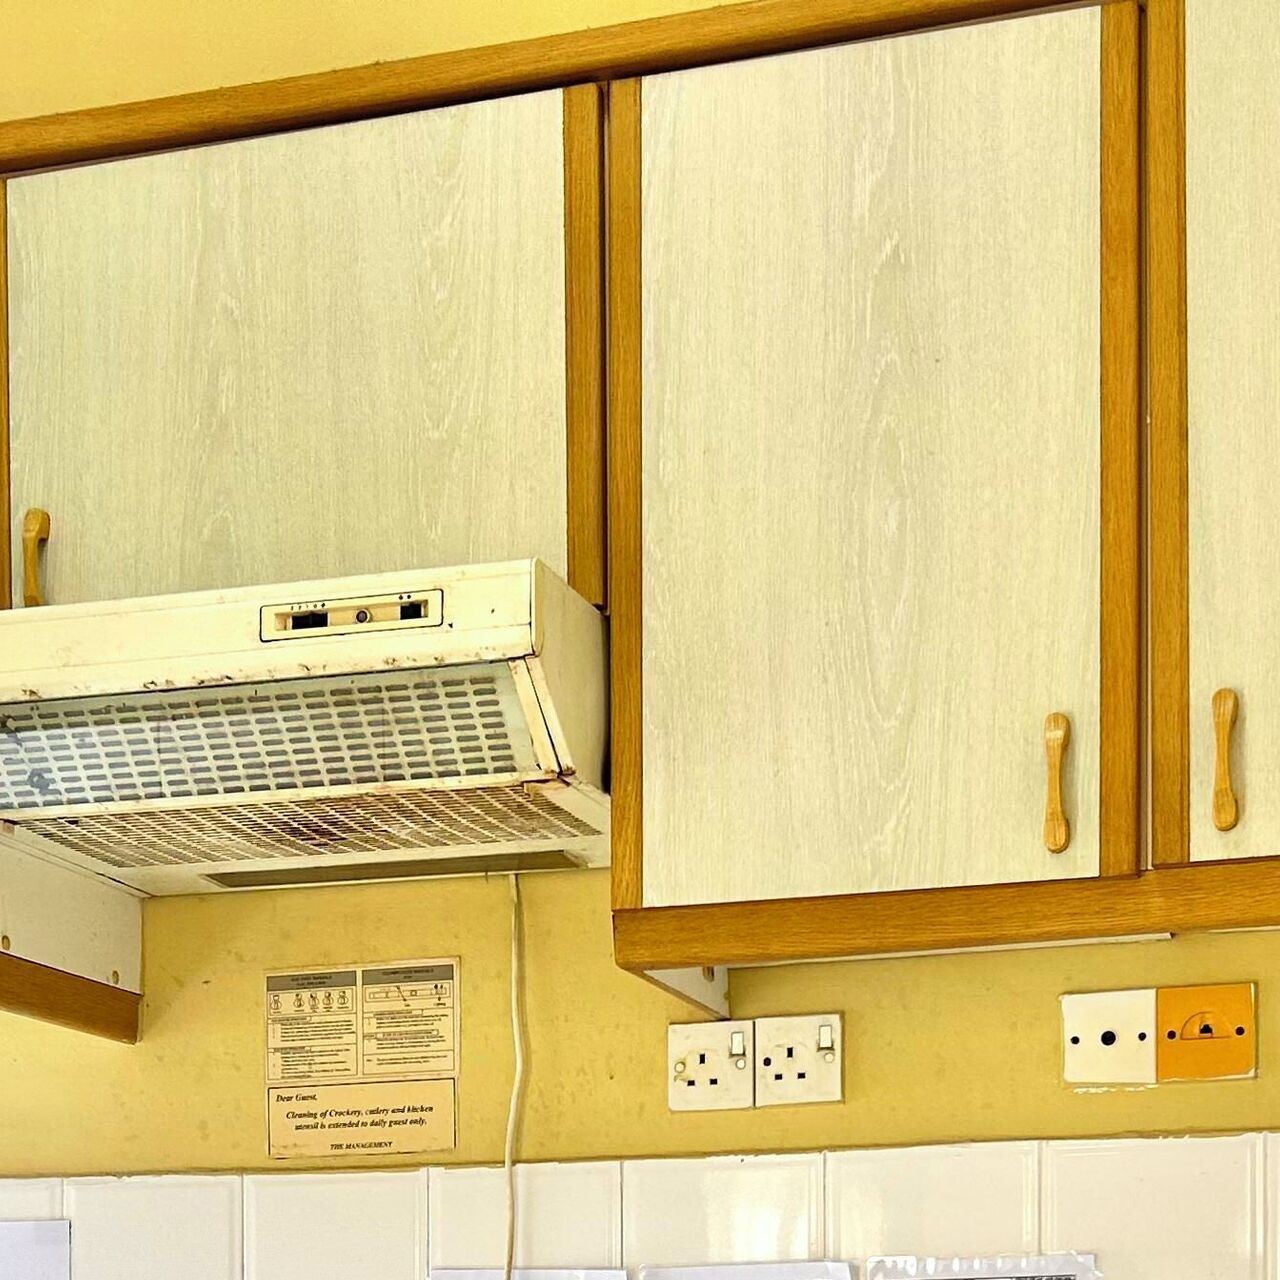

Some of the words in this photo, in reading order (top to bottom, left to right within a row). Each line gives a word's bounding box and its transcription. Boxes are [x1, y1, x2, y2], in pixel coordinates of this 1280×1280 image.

[275, 1094, 293, 1102] Dear
[286, 1110, 318, 1119] Cleaning
[320, 1109, 329, 1119] of
[365, 1107, 390, 1116] cutlery
[407, 1105, 433, 1113] kitchen
[320, 1121, 326, 1129] is
[328, 1120, 360, 1128] extended
[369, 1118, 387, 1128] daily
[388, 1118, 408, 1127] guest
[345, 1141, 393, 1150] MANAGEMENT
